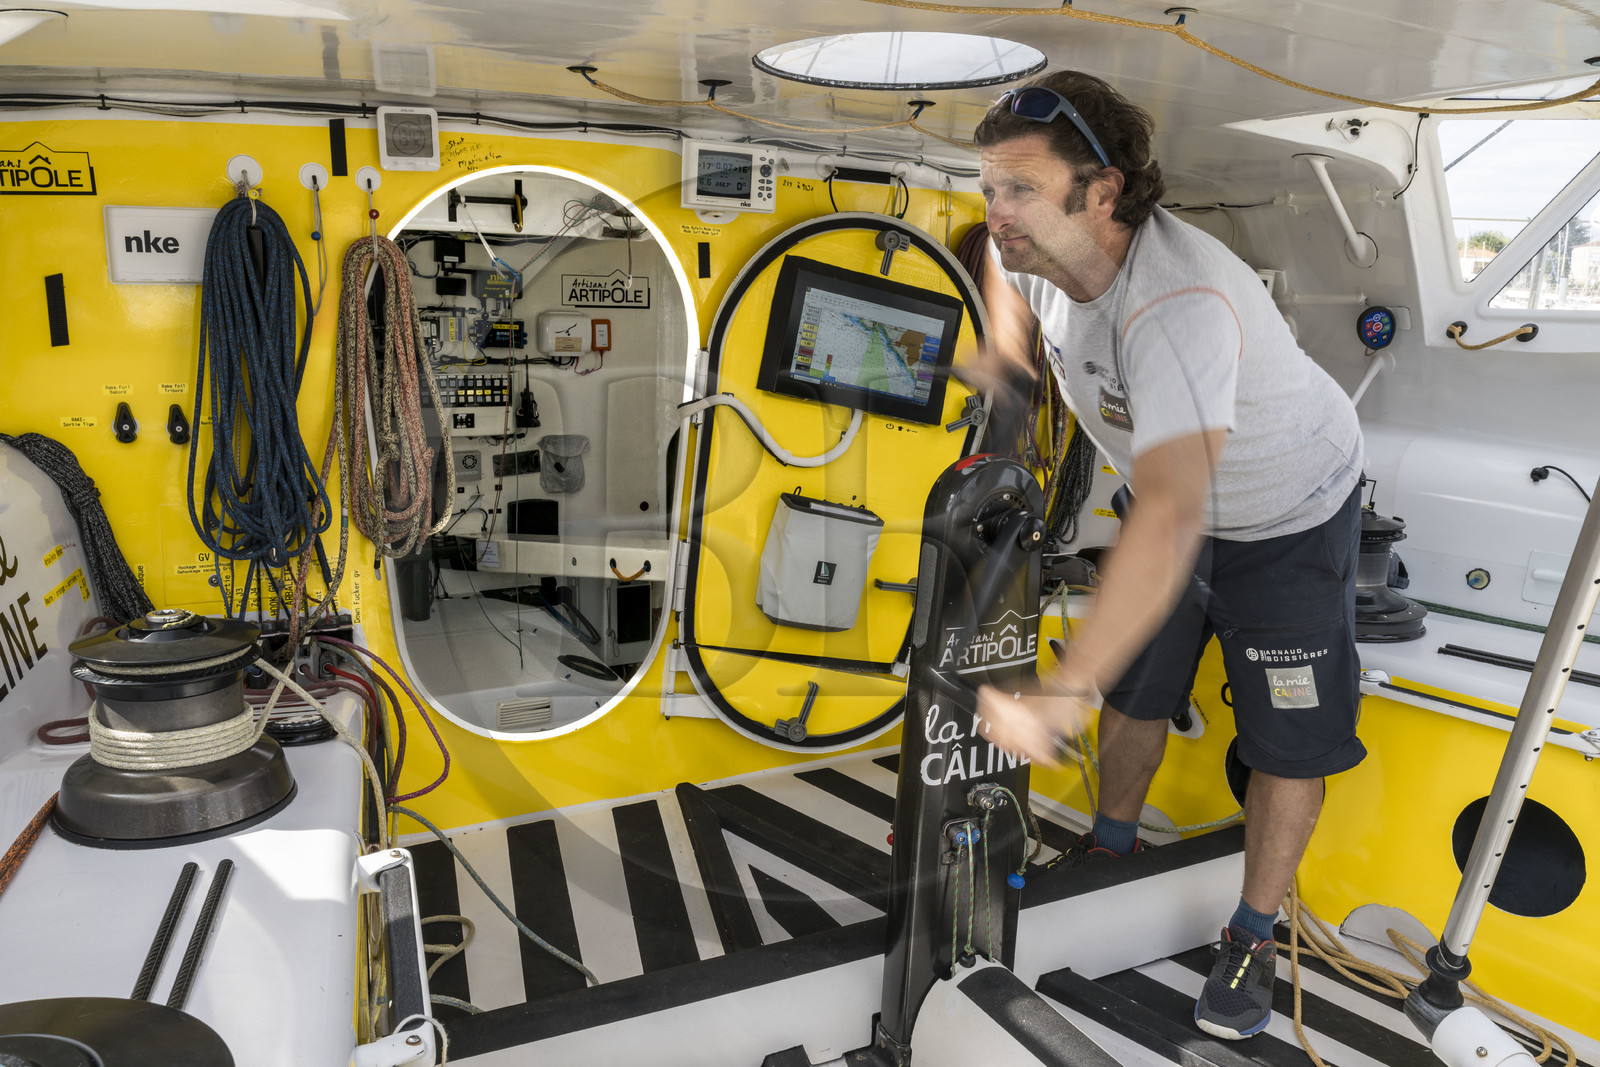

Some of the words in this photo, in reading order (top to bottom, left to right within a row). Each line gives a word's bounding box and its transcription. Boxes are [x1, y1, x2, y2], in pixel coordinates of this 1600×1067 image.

[740, 200, 752, 208] nke
[124, 229, 180, 254] nke
[572, 278, 608, 289] Artisans
[198, 553, 210, 562] GV
[236, 588, 243, 597] J3
[251, 587, 258, 596] J4
[269, 596, 278, 617] HOOK
[1265, 648, 1302, 656] ARNAUD
[1273, 675, 1285, 686] la
[1286, 675, 1310, 686] mie
[924, 704, 965, 745] la
